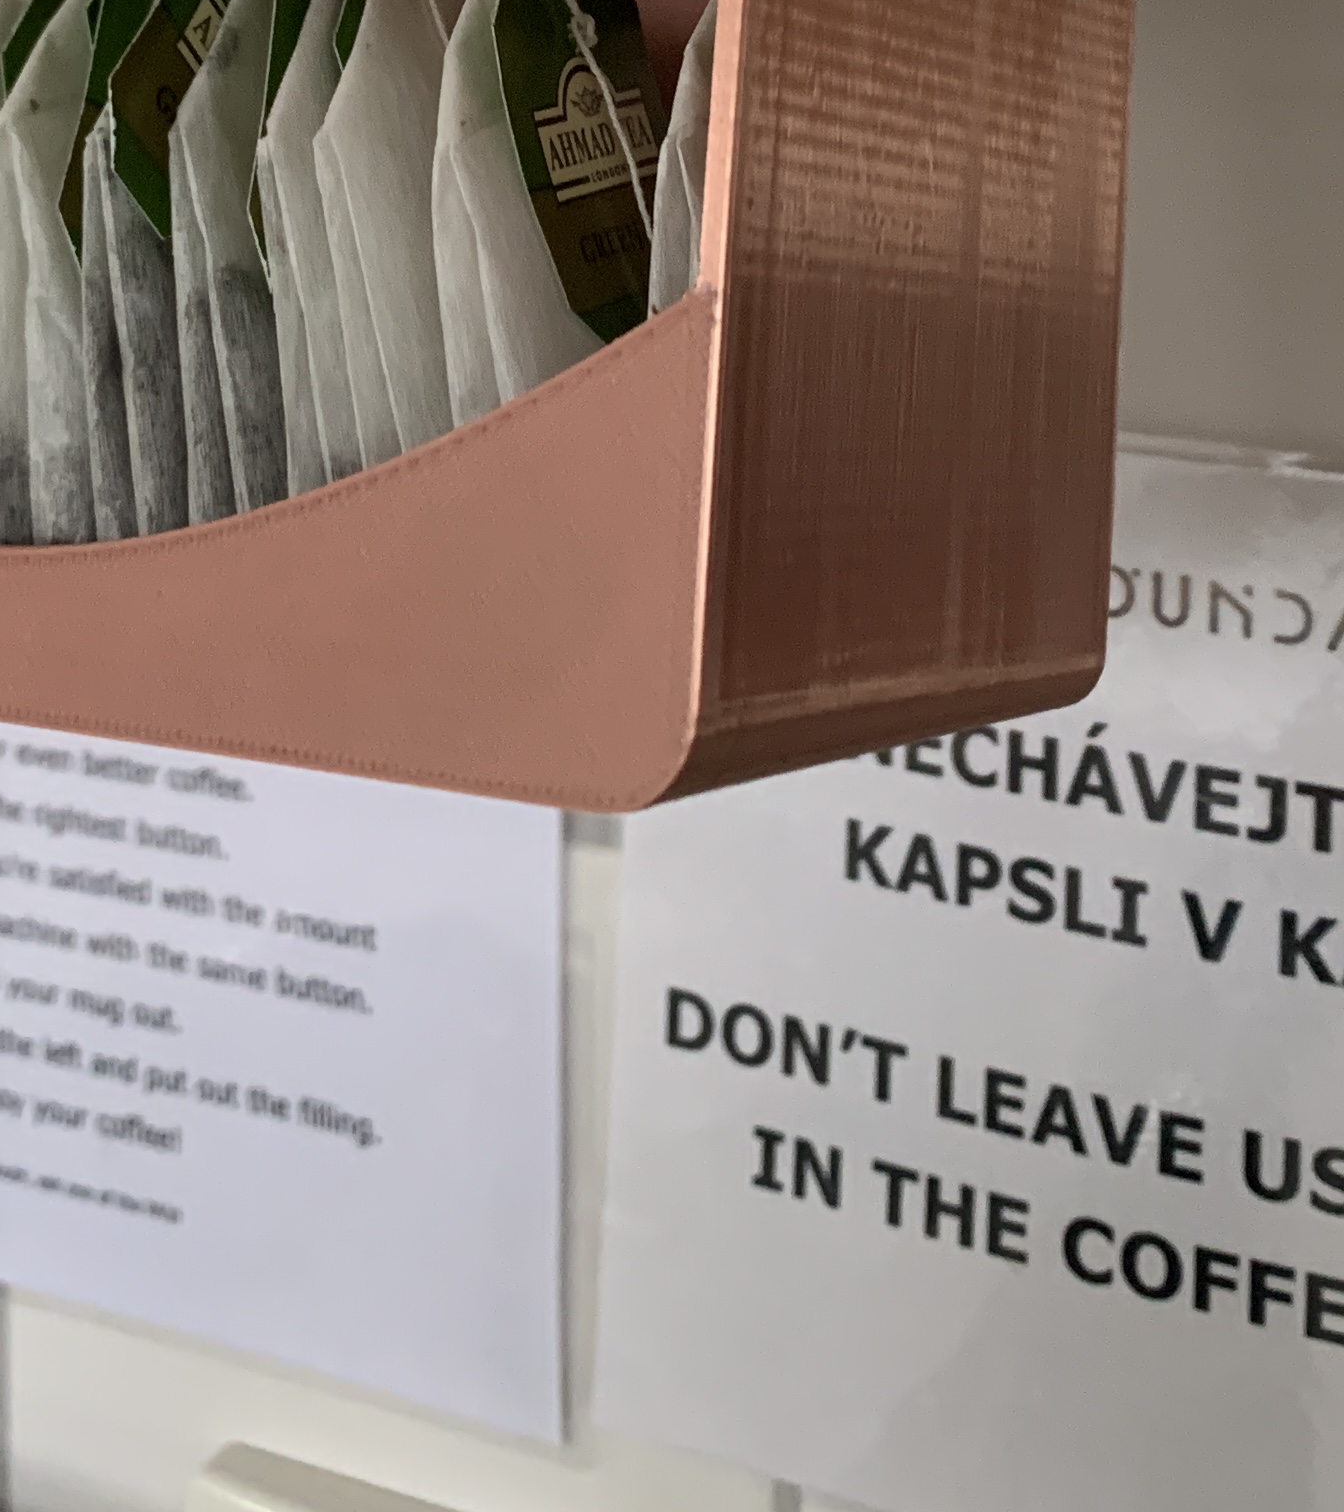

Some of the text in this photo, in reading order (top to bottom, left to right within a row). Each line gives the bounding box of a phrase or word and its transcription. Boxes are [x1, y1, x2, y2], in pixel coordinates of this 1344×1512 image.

[548, 114, 652, 172] AHMAD EA
[14, 743, 75, 773] even
[83, 749, 159, 786] better
[164, 765, 255, 802] coffee.
[136, 817, 230, 862] button.
[48, 865, 153, 906] satisfied
[159, 888, 216, 918] with
[220, 894, 267, 928] the
[274, 908, 378, 952] amount
[844, 817, 1149, 949] KAPSLI
[1180, 889, 1242, 964] V
[7, 977, 58, 1007] your
[66, 987, 126, 1028] mug
[85, 932, 139, 962] with
[146, 940, 190, 975] the
[196, 954, 268, 991] same
[274, 964, 374, 1016] button.
[31, 1096, 89, 1130] your
[42, 1034, 83, 1069] left
[89, 1051, 139, 1084] and
[143, 1065, 187, 1098] put
[195, 1077, 241, 1110] out
[245, 1085, 291, 1123] the
[297, 1094, 383, 1151] filling.
[936, 1054, 1205, 1185] LEAVE
[751, 1124, 844, 1211] IN
[870, 1156, 1031, 1266] THE
